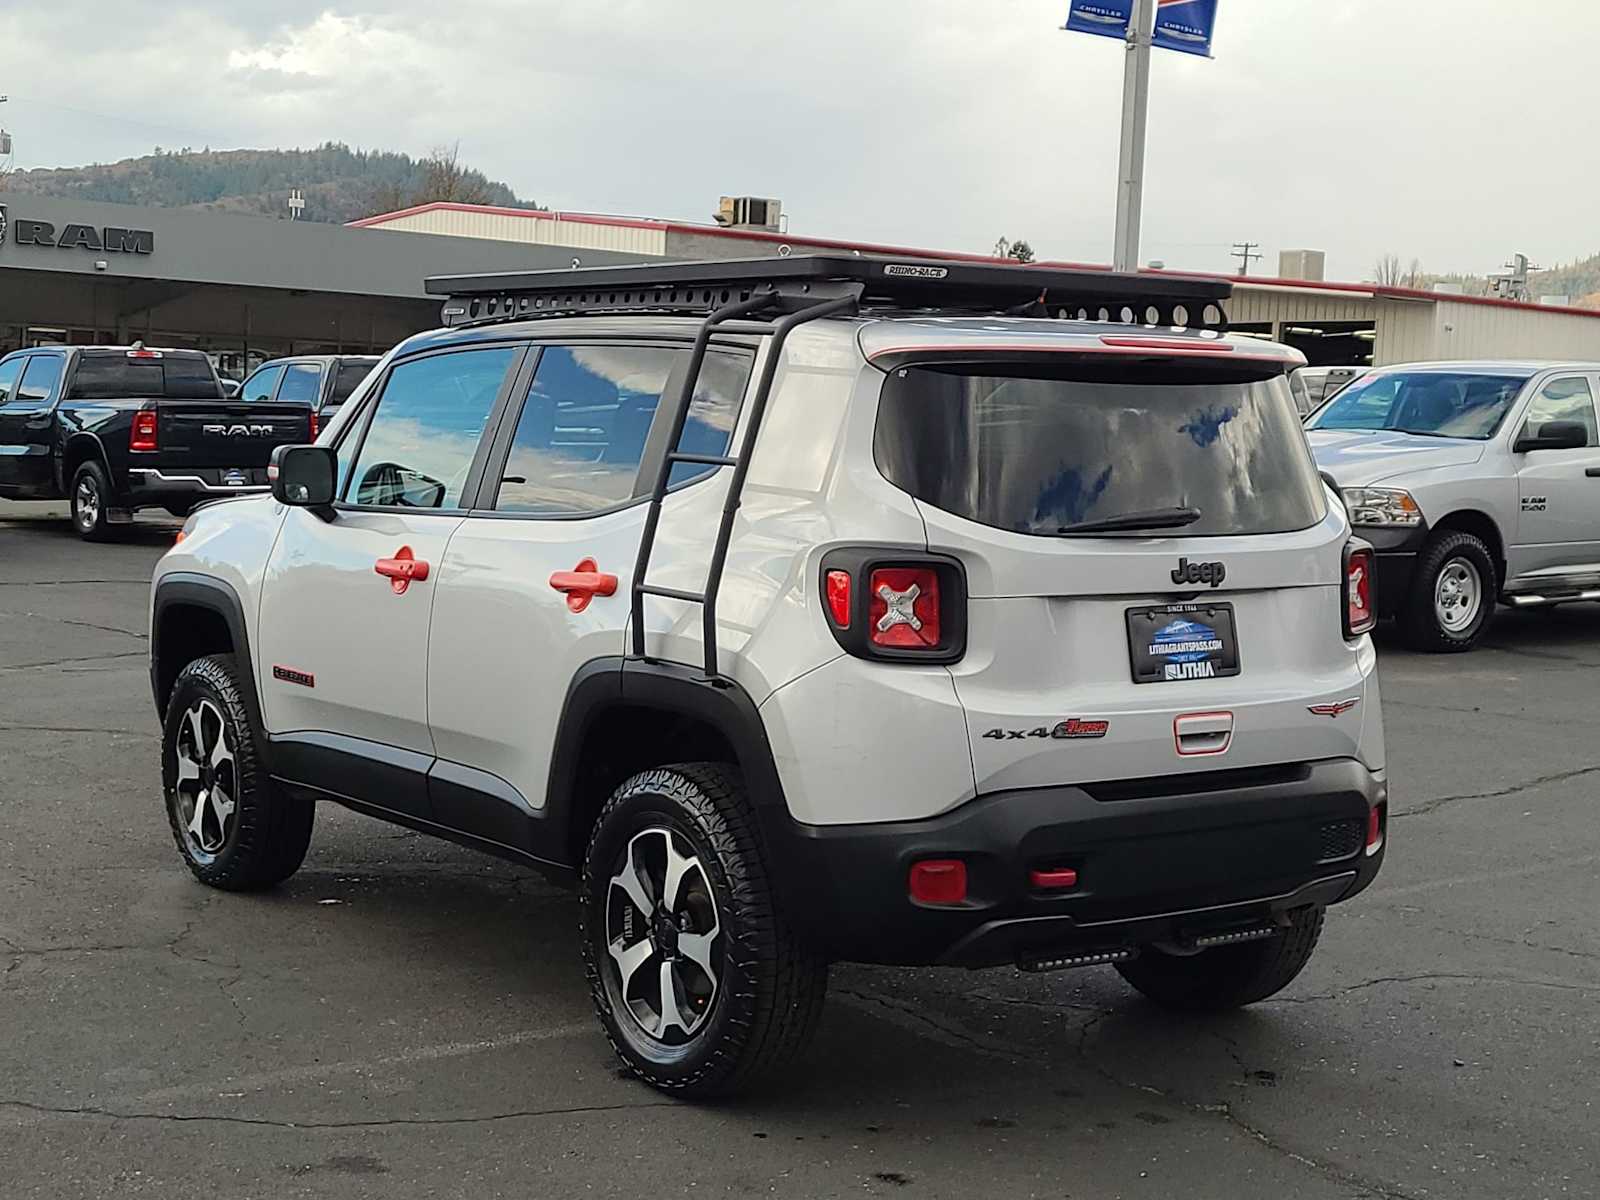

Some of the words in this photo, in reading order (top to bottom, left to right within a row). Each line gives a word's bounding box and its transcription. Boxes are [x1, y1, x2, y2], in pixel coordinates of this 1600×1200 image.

[1079, 5, 1122, 17] CHRYSLER
[1164, 22, 1203, 35] CHRYSLER
[15, 218, 154, 255] RAM
[202, 424, 273, 436] RAM
[1171, 557, 1226, 587] Jeep
[1176, 661, 1215, 680] LITHIA
